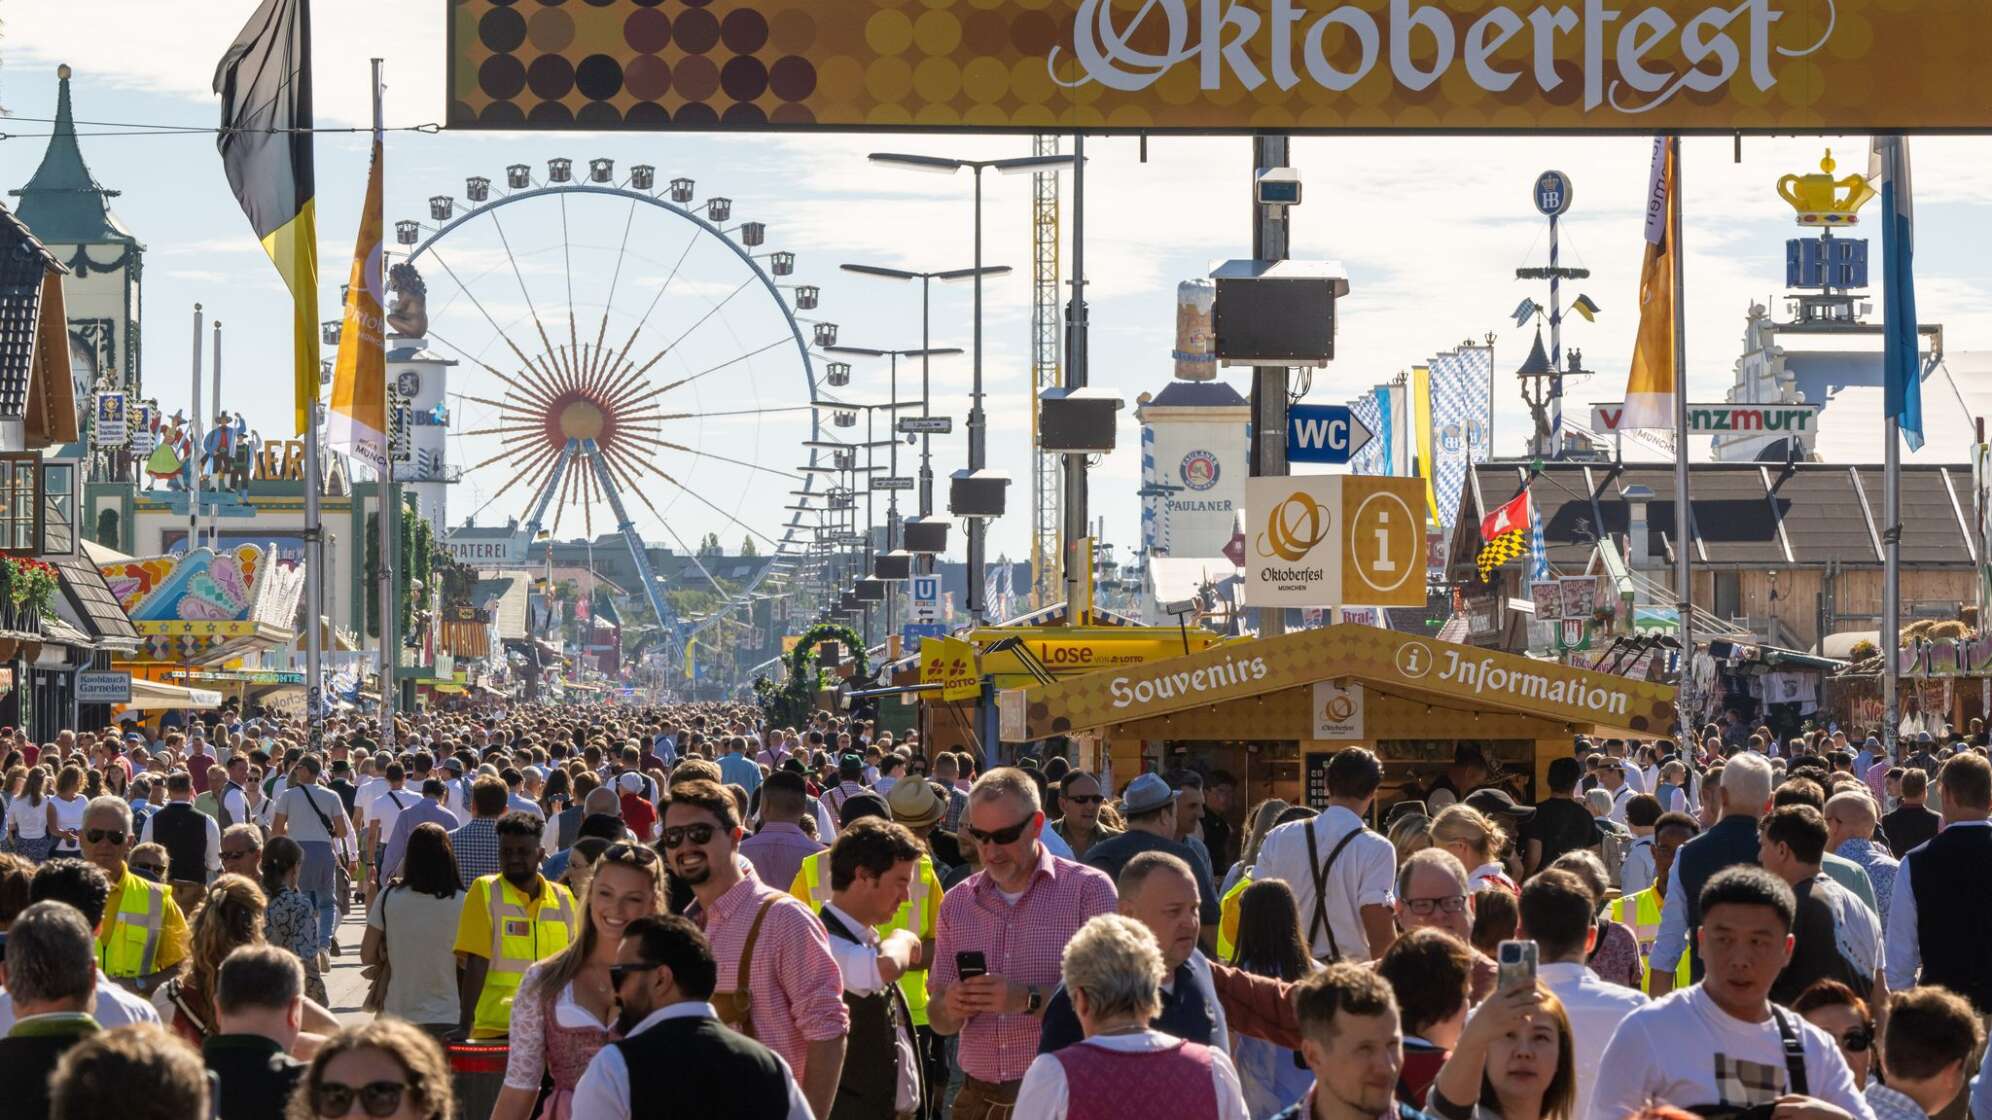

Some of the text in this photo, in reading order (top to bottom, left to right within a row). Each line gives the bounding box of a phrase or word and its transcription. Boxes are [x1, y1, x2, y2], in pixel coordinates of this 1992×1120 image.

[1048, 0, 1836, 114] Oktoberfest
[1542, 191, 1560, 209] HB
[1294, 419, 1347, 450] WC
[1168, 500, 1232, 512] PAULANER
[1260, 566, 1323, 583] Oktoberfest
[919, 581, 932, 599] U
[1042, 642, 1094, 664] Lose
[1119, 655, 1144, 664] LOTTO
[79, 684, 128, 694] Garnelen
[944, 677, 977, 689] LOTTO
[1110, 655, 1268, 709] Souvenirs
[1437, 650, 1628, 715] Information
